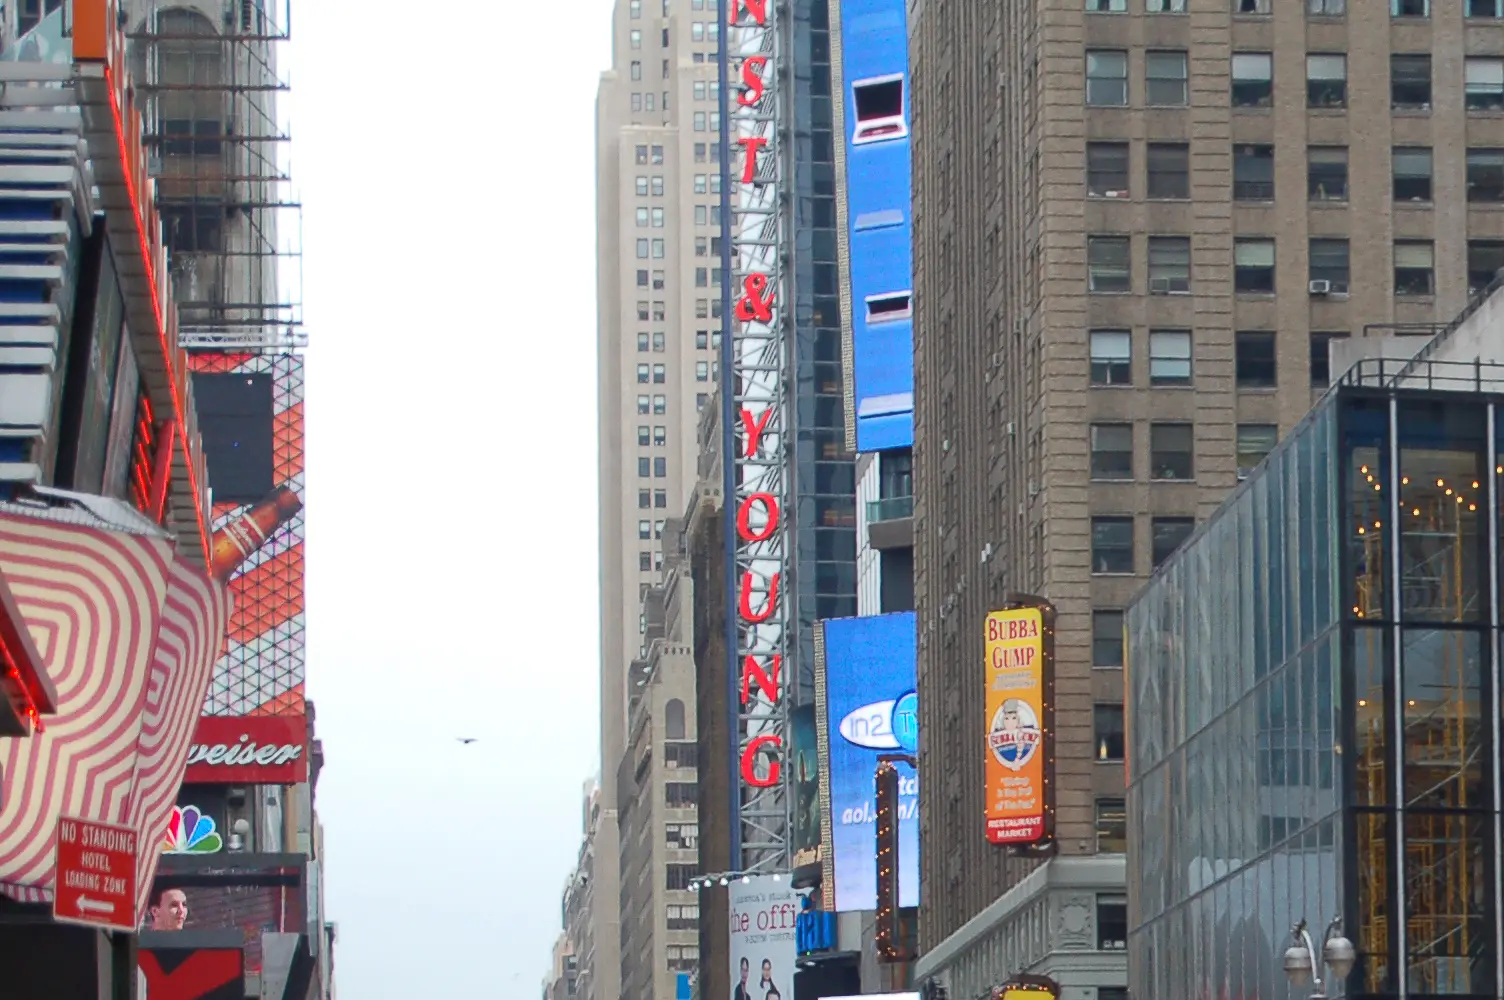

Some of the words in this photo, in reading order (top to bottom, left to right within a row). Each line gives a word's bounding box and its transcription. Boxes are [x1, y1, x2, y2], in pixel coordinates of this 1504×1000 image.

[736, 408, 782, 788] YOUNG
[989, 617, 1039, 641] BUBBA
[992, 646, 1035, 669] GUMP
[61, 820, 77, 844] NO
[81, 824, 133, 855] STANDING
[81, 851, 111, 873] HOTEL
[65, 869, 100, 892] LOADING
[103, 875, 127, 896] ZONE
